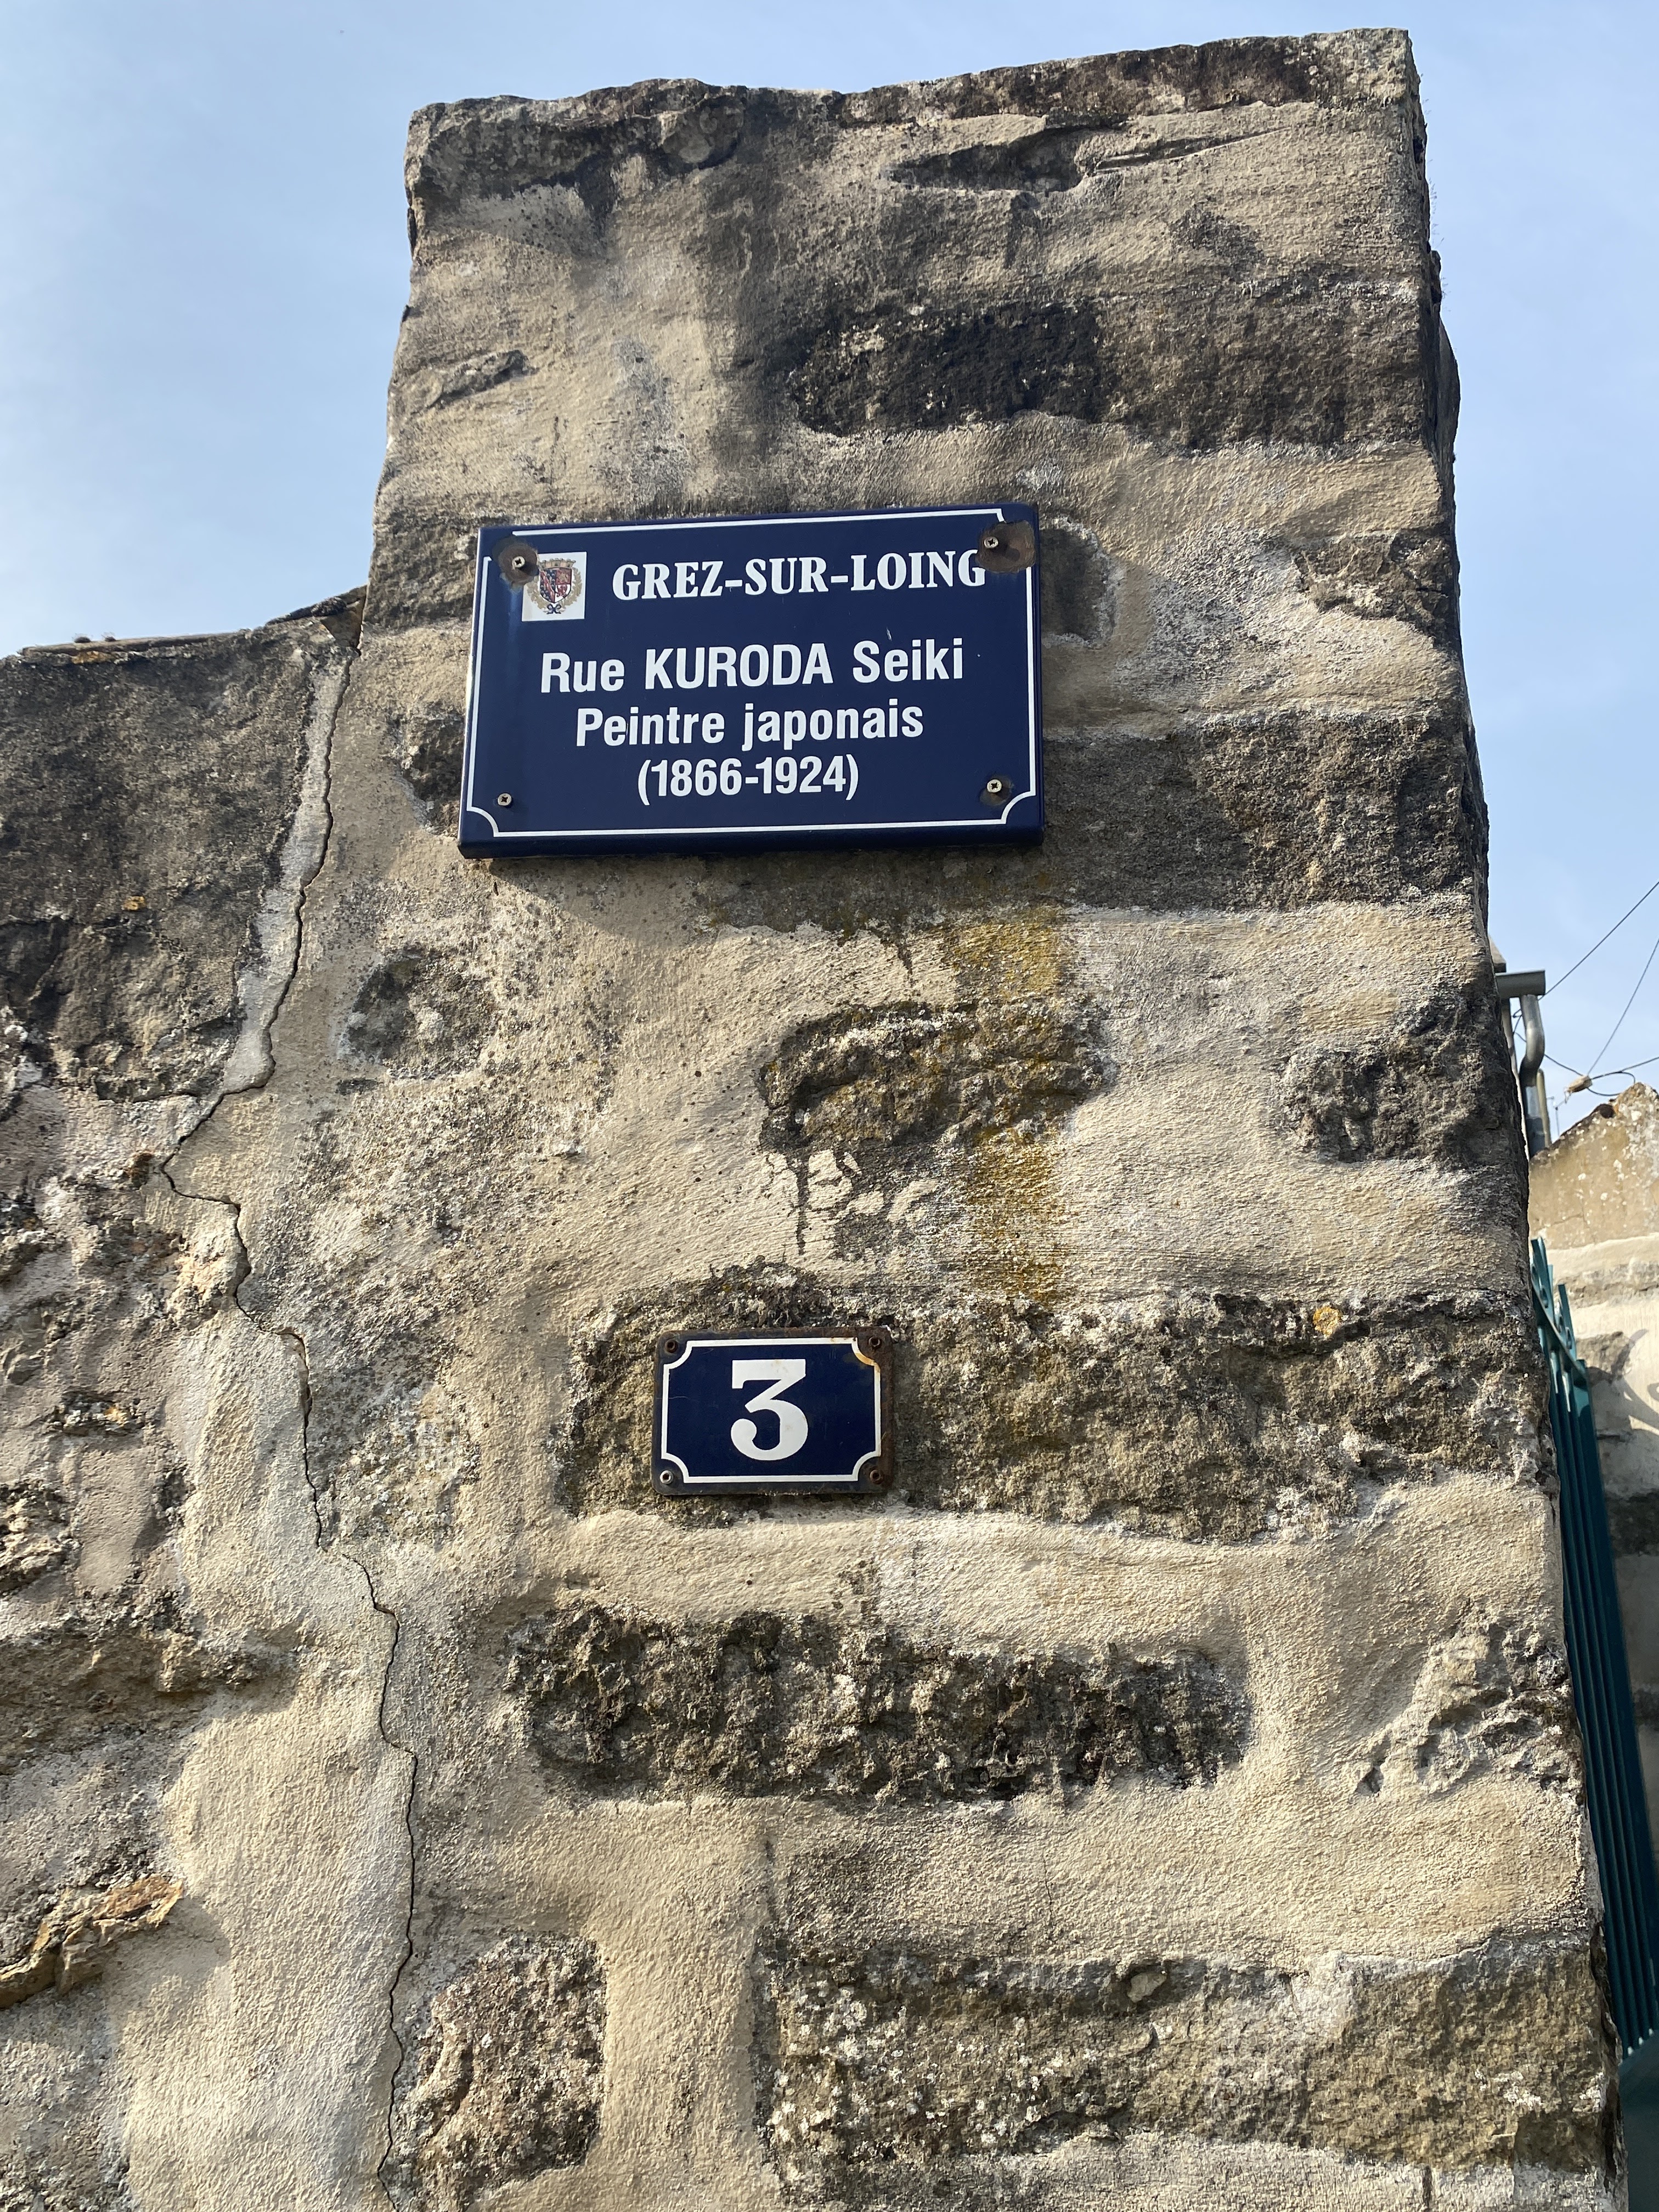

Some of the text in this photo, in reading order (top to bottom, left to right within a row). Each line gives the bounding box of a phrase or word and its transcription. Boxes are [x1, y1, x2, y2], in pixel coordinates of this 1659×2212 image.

[612, 549, 986, 601] GREZ-SUR-LOING
[541, 637, 963, 693] Rue KURODA Seiki
[576, 698, 923, 752] Peintre japonais
[637, 754, 859, 806] (1866-1924)
[730, 1358, 809, 1461] 3
